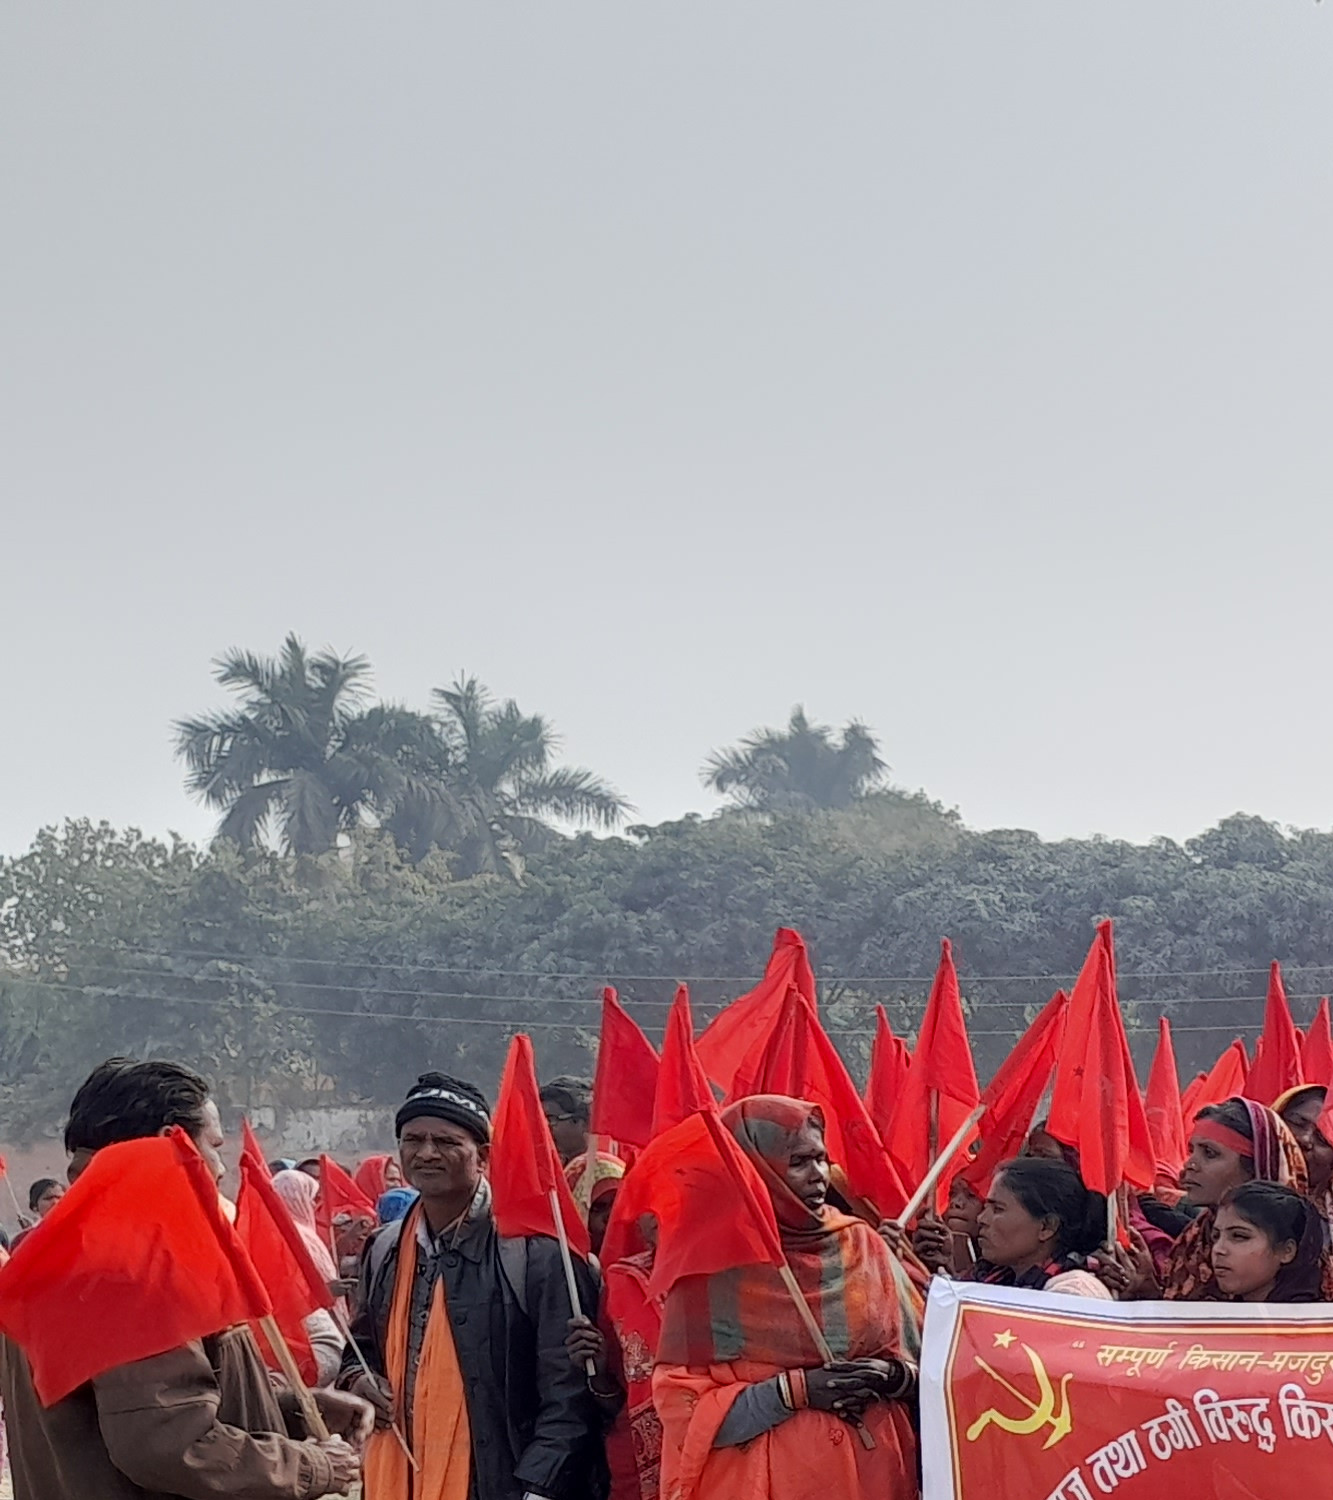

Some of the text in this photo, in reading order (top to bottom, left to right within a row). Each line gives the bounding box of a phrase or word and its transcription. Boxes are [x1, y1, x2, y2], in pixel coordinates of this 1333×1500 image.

[1096, 1341, 1179, 1378] सम्पूर्ण
[1085, 1429, 1148, 1493] तथा
[1141, 1398, 1202, 1460] ठगी
